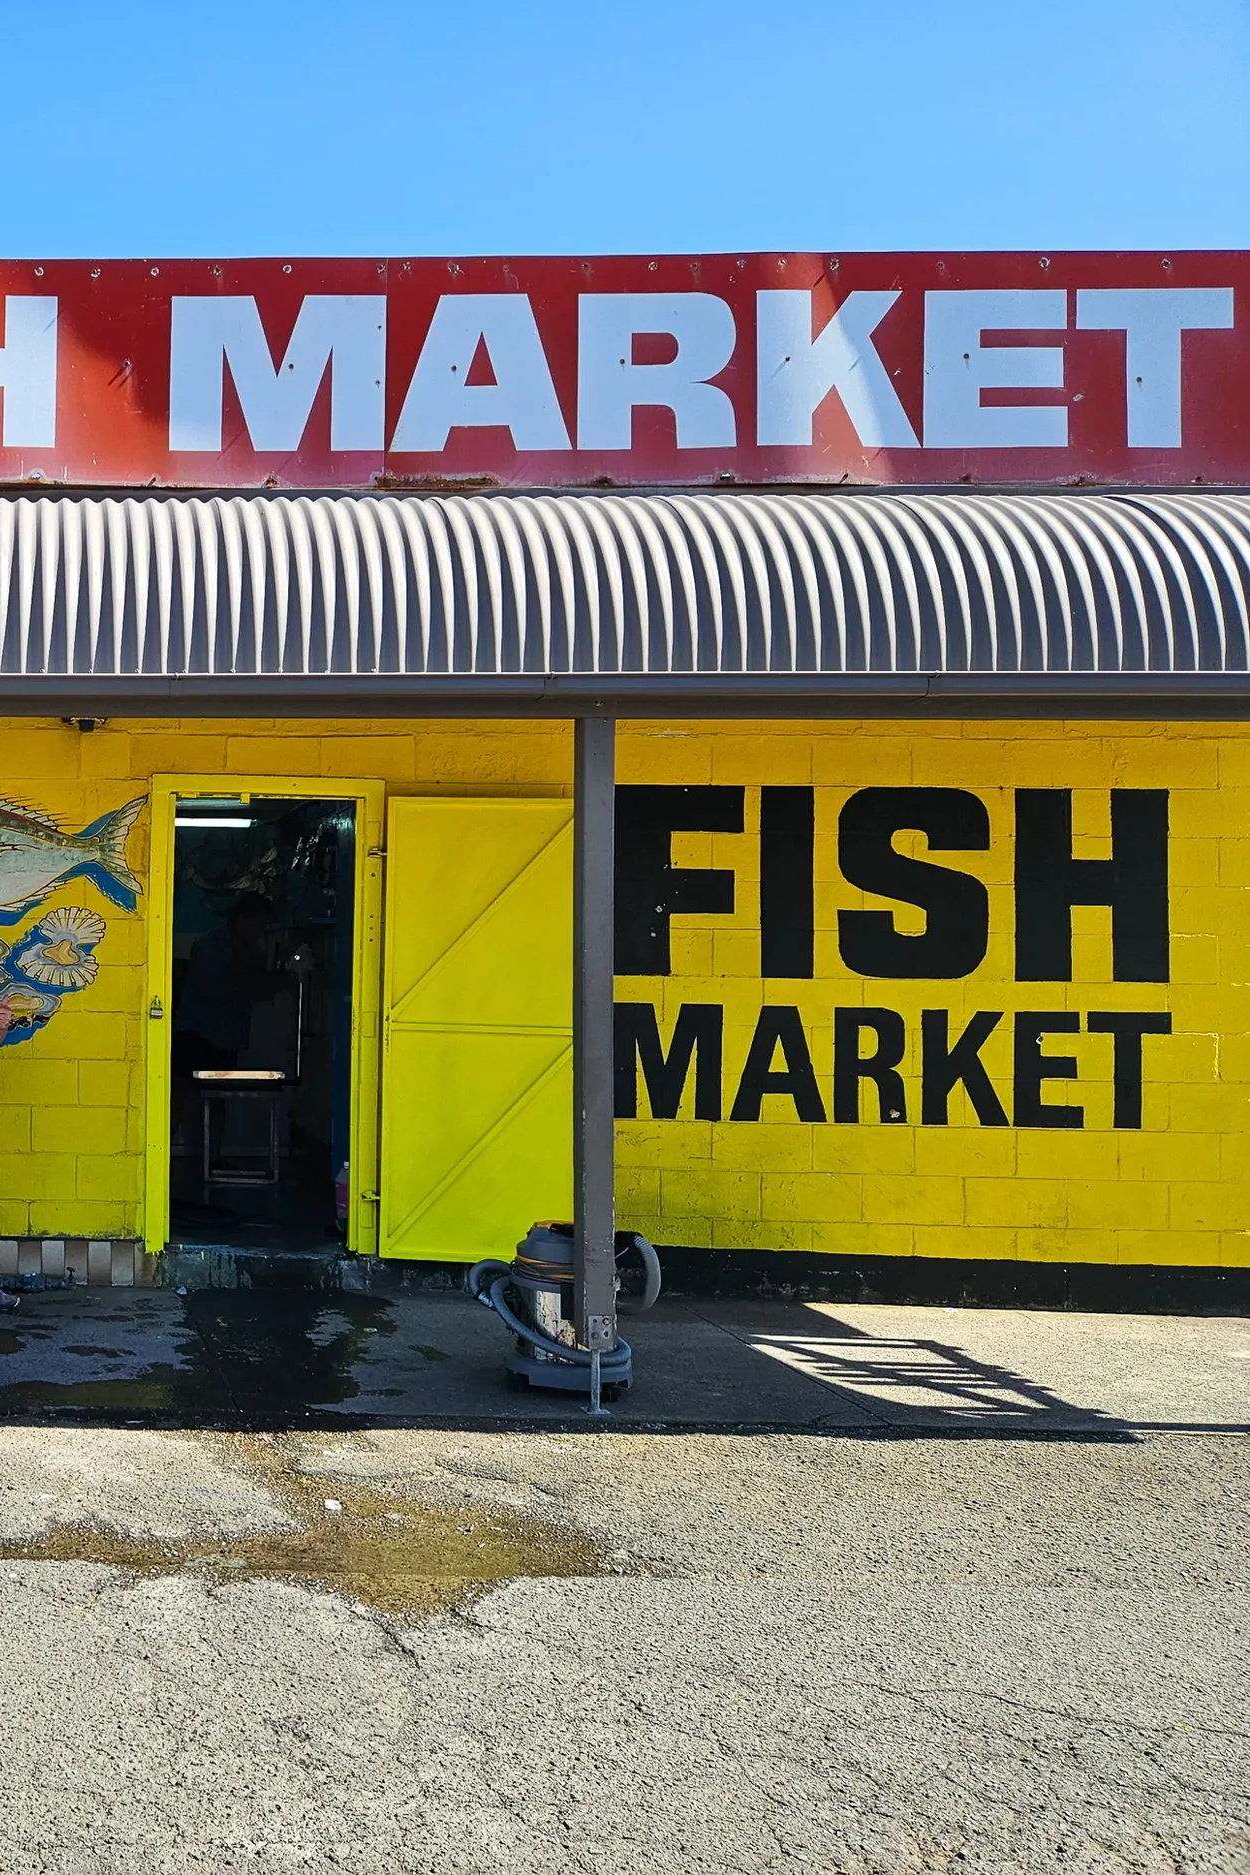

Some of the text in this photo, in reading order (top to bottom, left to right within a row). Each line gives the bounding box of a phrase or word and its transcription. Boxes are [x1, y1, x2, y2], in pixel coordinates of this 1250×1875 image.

[169, 287, 1235, 452] MARKET
[614, 784, 1170, 982] FISH
[614, 1003, 1173, 1129] MARKET
